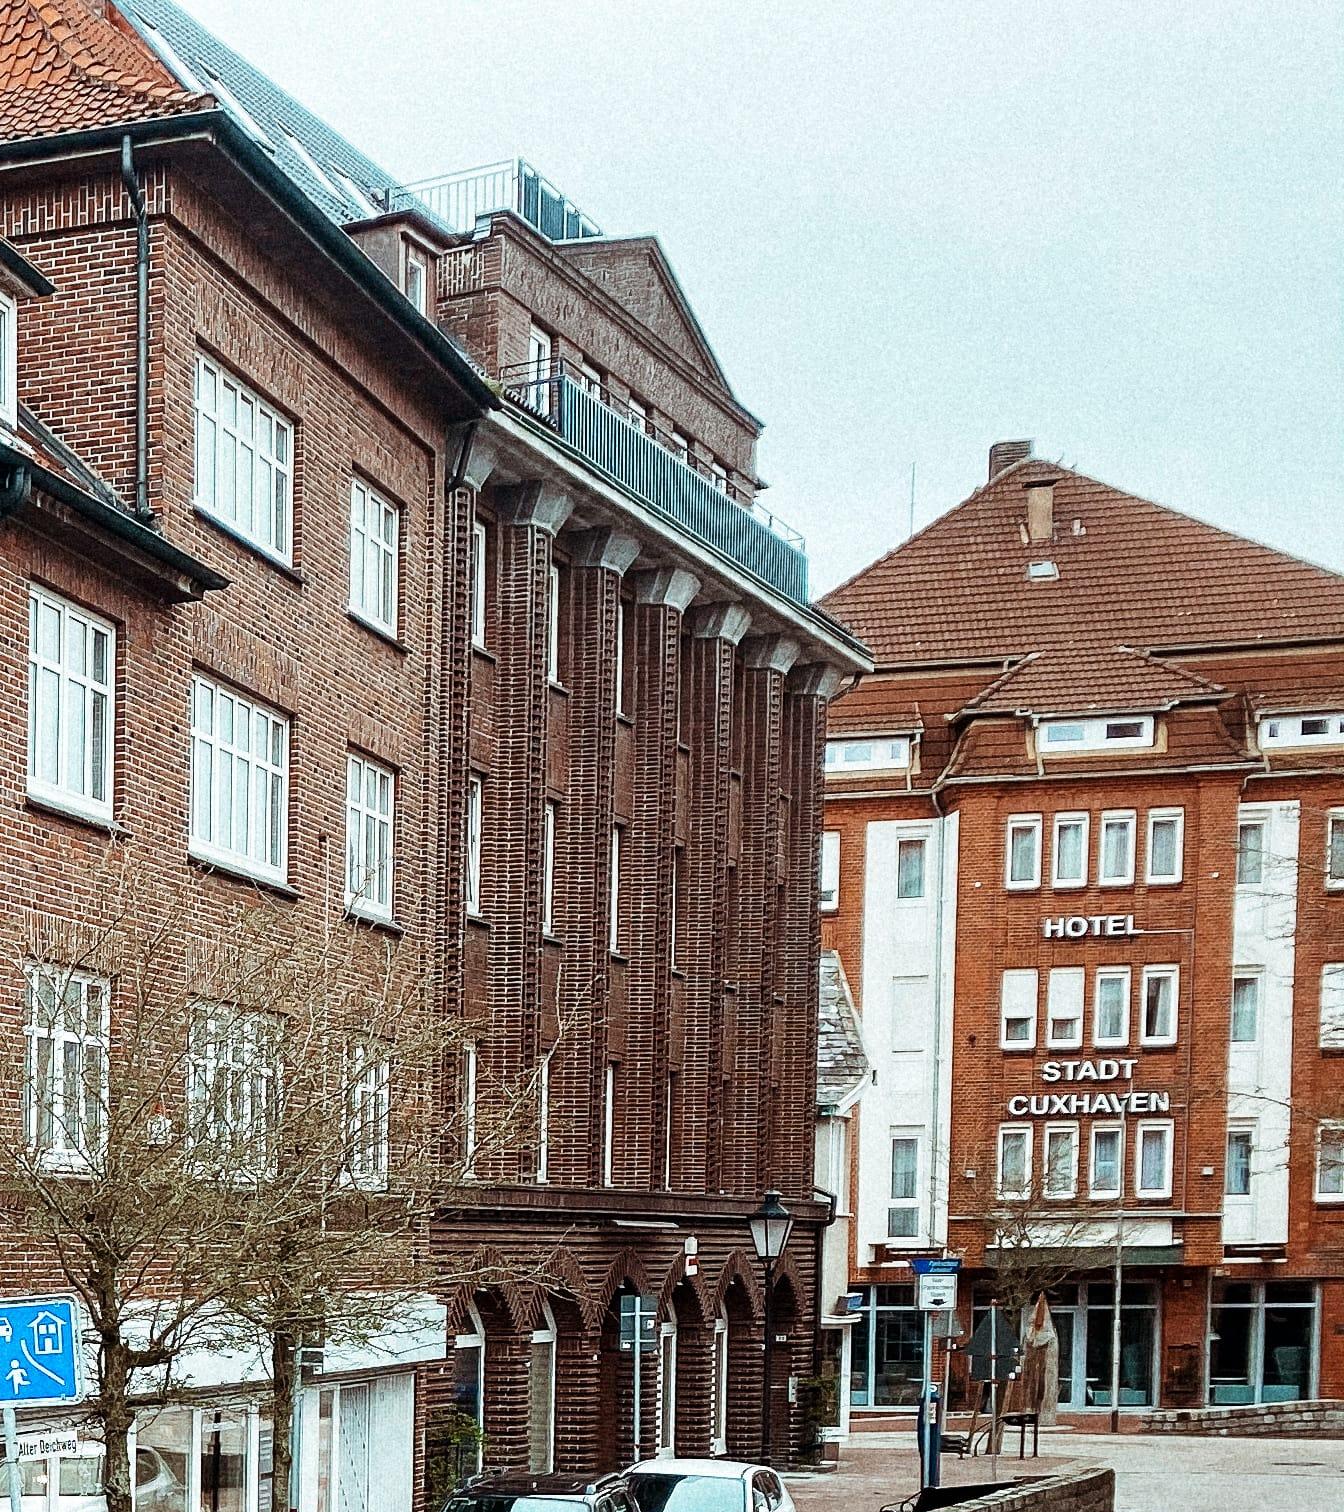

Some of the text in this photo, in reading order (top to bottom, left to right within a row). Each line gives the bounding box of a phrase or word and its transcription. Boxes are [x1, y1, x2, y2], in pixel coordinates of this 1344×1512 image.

[1045, 914, 1144, 938] HOTEL
[1041, 1059, 1139, 1082] STADT
[1008, 1091, 1170, 1115] CUXHAVEN
[18, 1442, 38, 1457] Alter
